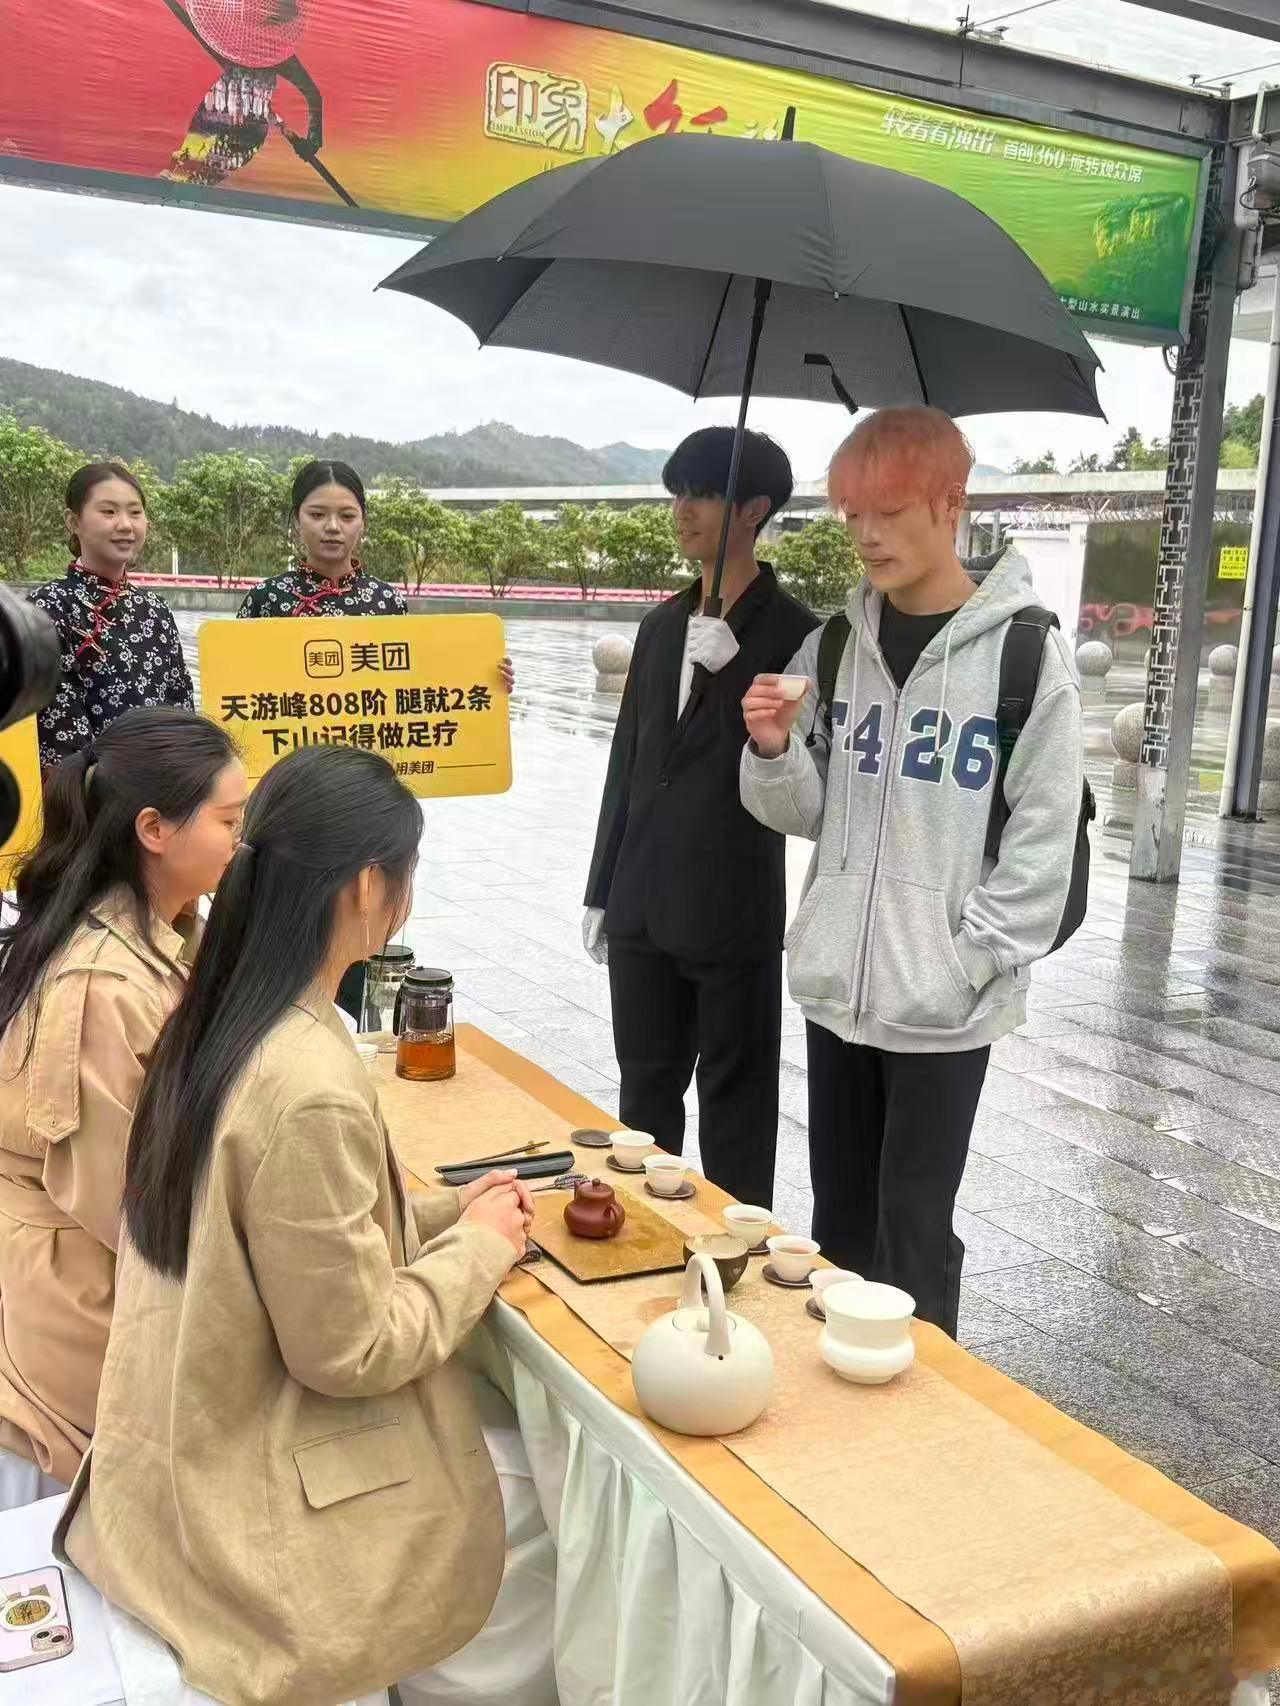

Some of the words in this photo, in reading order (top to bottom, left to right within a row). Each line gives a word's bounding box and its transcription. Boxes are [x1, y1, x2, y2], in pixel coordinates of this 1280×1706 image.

[491, 122, 546, 141] IMPRESSION
[308, 651, 340, 667] 美团
[350, 642, 410, 672] 美团
[221, 688, 387, 721] 天游峰808阶
[395, 684, 492, 714] 腿就2条
[262, 720, 459, 755] 下山记得做足疗
